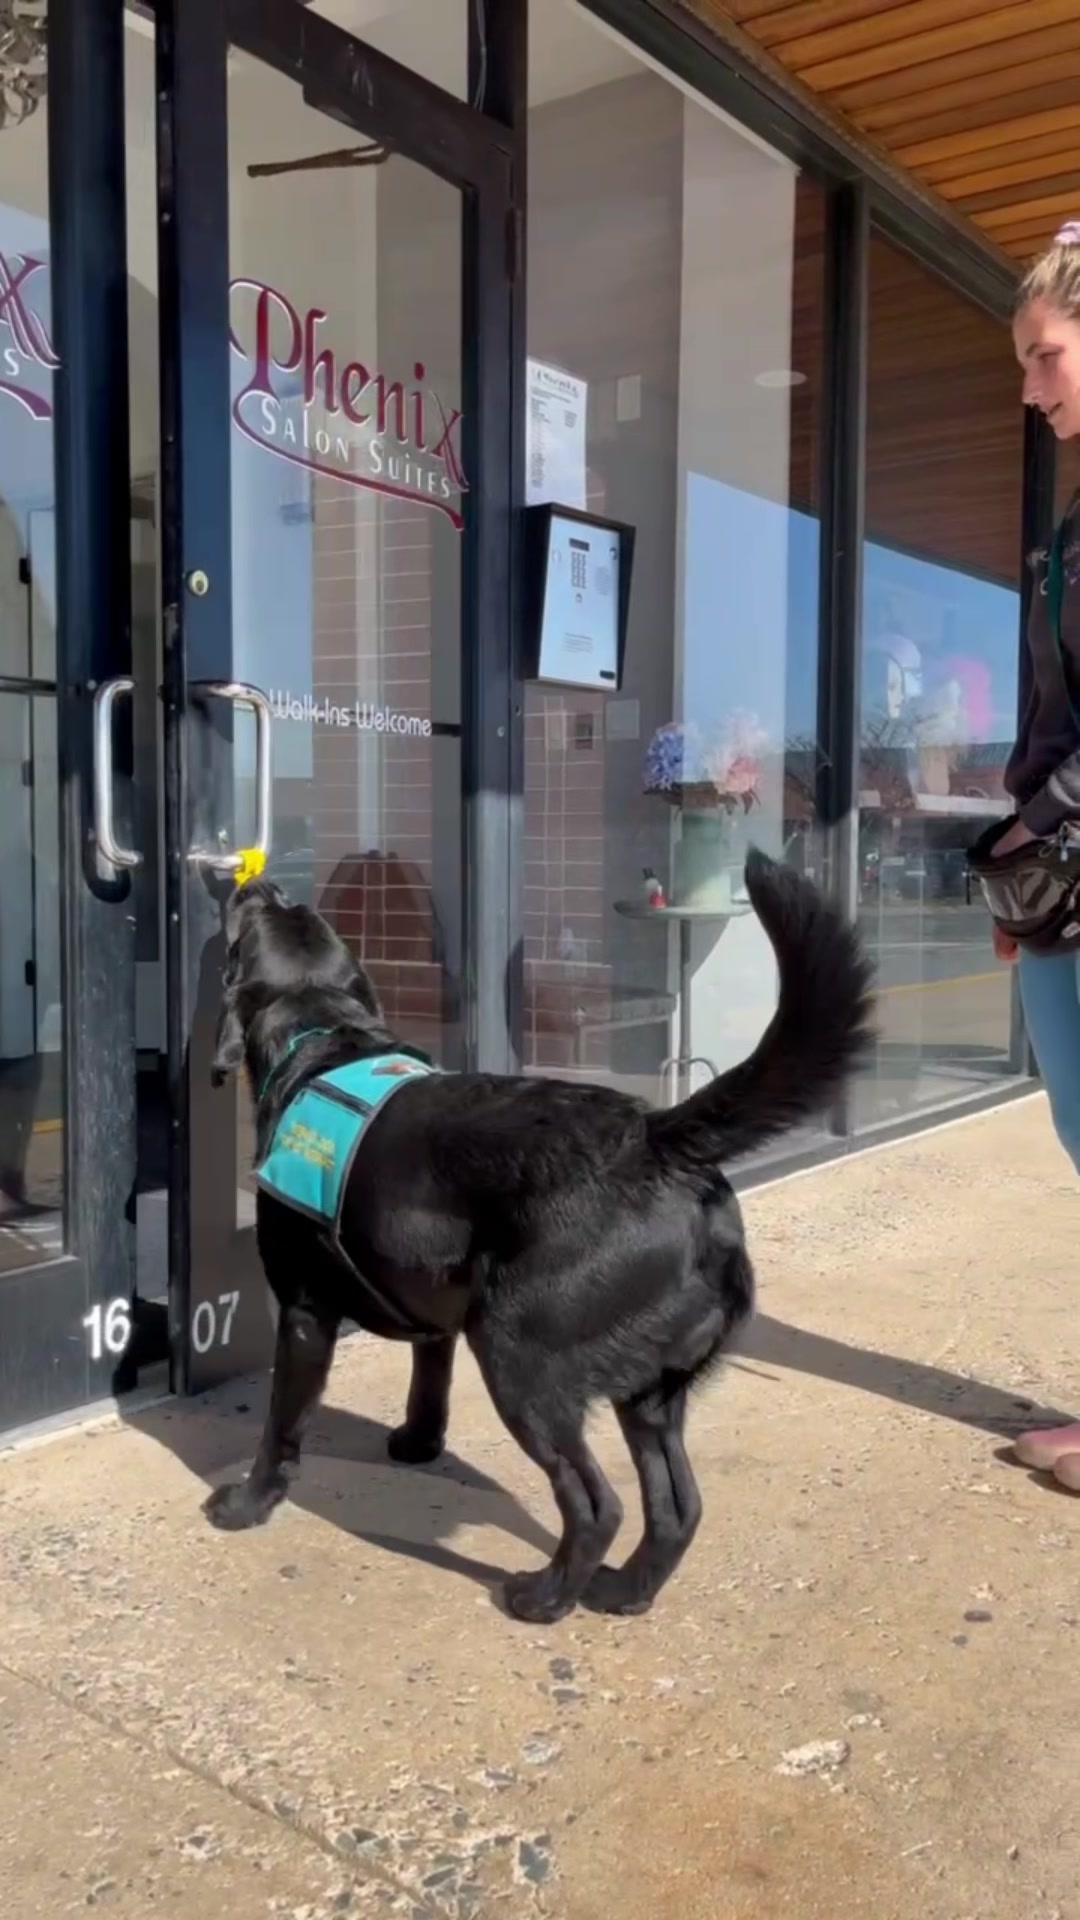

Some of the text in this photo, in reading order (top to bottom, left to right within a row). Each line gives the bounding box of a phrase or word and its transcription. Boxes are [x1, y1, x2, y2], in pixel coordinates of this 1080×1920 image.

[229, 278, 470, 493] Phenix
[269, 688, 433, 737] Walk-Ins Welcome
[83, 1297, 132, 1361] 16
